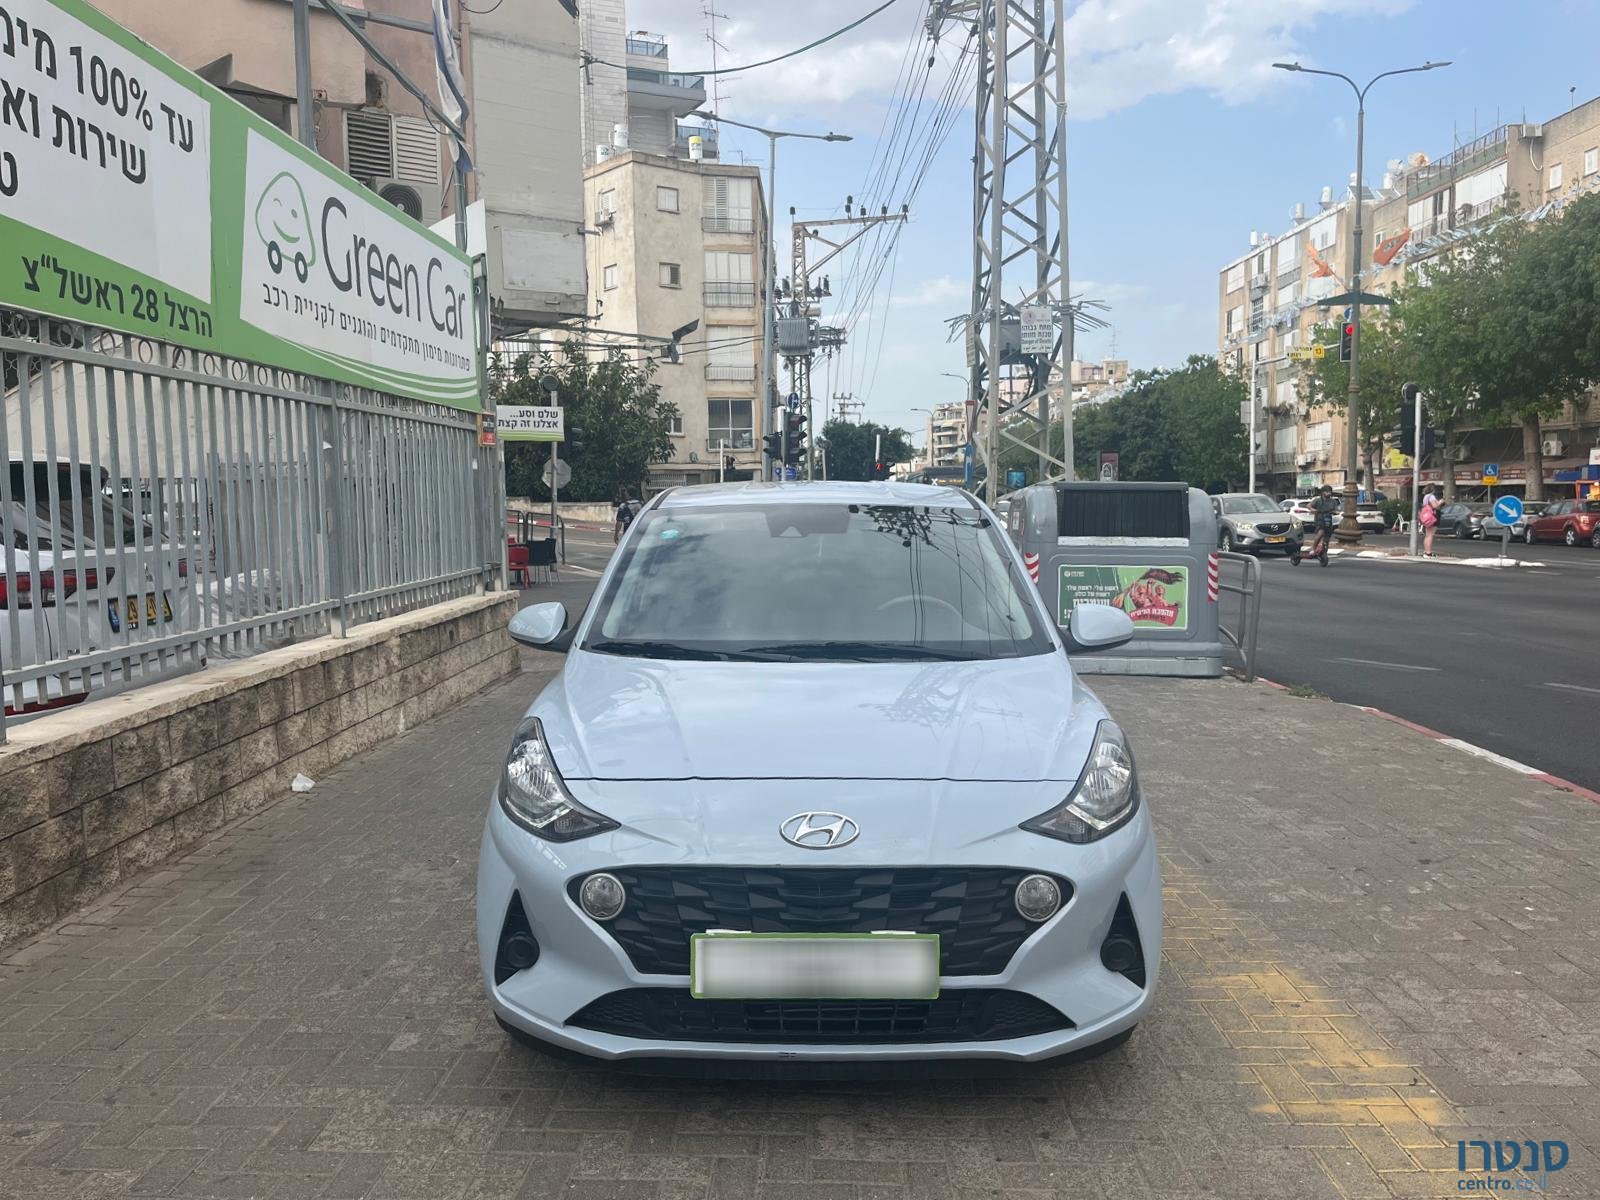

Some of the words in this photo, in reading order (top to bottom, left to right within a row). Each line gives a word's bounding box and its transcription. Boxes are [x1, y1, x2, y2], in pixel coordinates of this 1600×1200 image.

[70, 46, 153, 131] 100%
[160, 102, 194, 152] עד
[52, 104, 146, 184] שירות
[321, 197, 422, 322] Green
[427, 257, 466, 340] Car
[130, 283, 159, 323] 28
[263, 283, 288, 311] רכב
[164, 292, 213, 338] הרצל
[295, 295, 334, 328] לקניית
[340, 312, 377, 340] והוגנים
[380, 327, 420, 355] מתקדמים
[422, 342, 443, 362] מימון
[444, 350, 470, 371] פתרונות
[498, 419, 517, 429] קצת
[520, 420, 530, 428] זה
[534, 420, 558, 428] אצלנו
[538, 409, 558, 418] שלם
